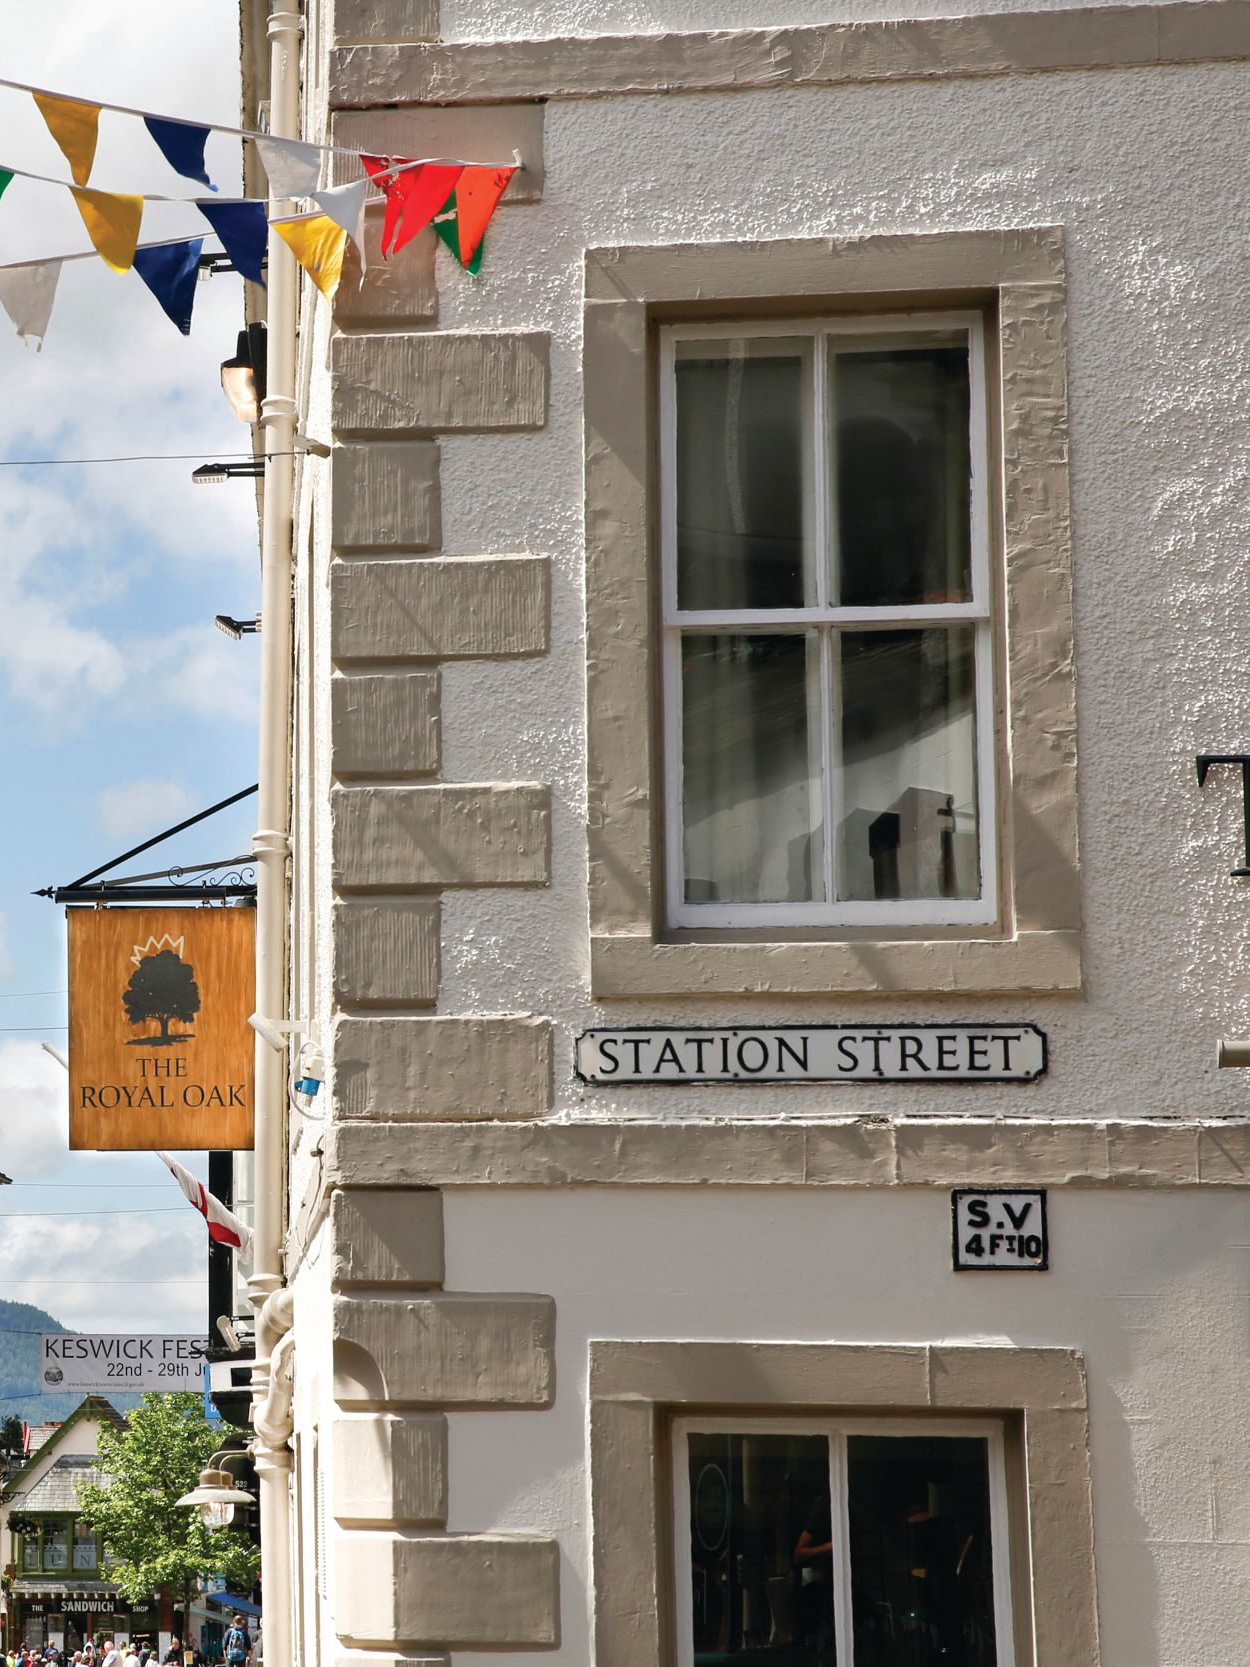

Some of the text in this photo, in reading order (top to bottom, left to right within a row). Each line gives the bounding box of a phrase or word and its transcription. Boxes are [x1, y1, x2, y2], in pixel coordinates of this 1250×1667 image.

[598, 1034, 1022, 1075] STATION STREET
[135, 1058, 188, 1078] THE
[80, 1084, 247, 1109] ROYAL OAK
[45, 1338, 154, 1359] KESWICK
[106, 1363, 142, 1377] 22nd
[158, 1362, 189, 1377] 29th
[194, 1363, 206, 1377] J
[31, 1601, 149, 1613] THE SANDWICH SHOP
